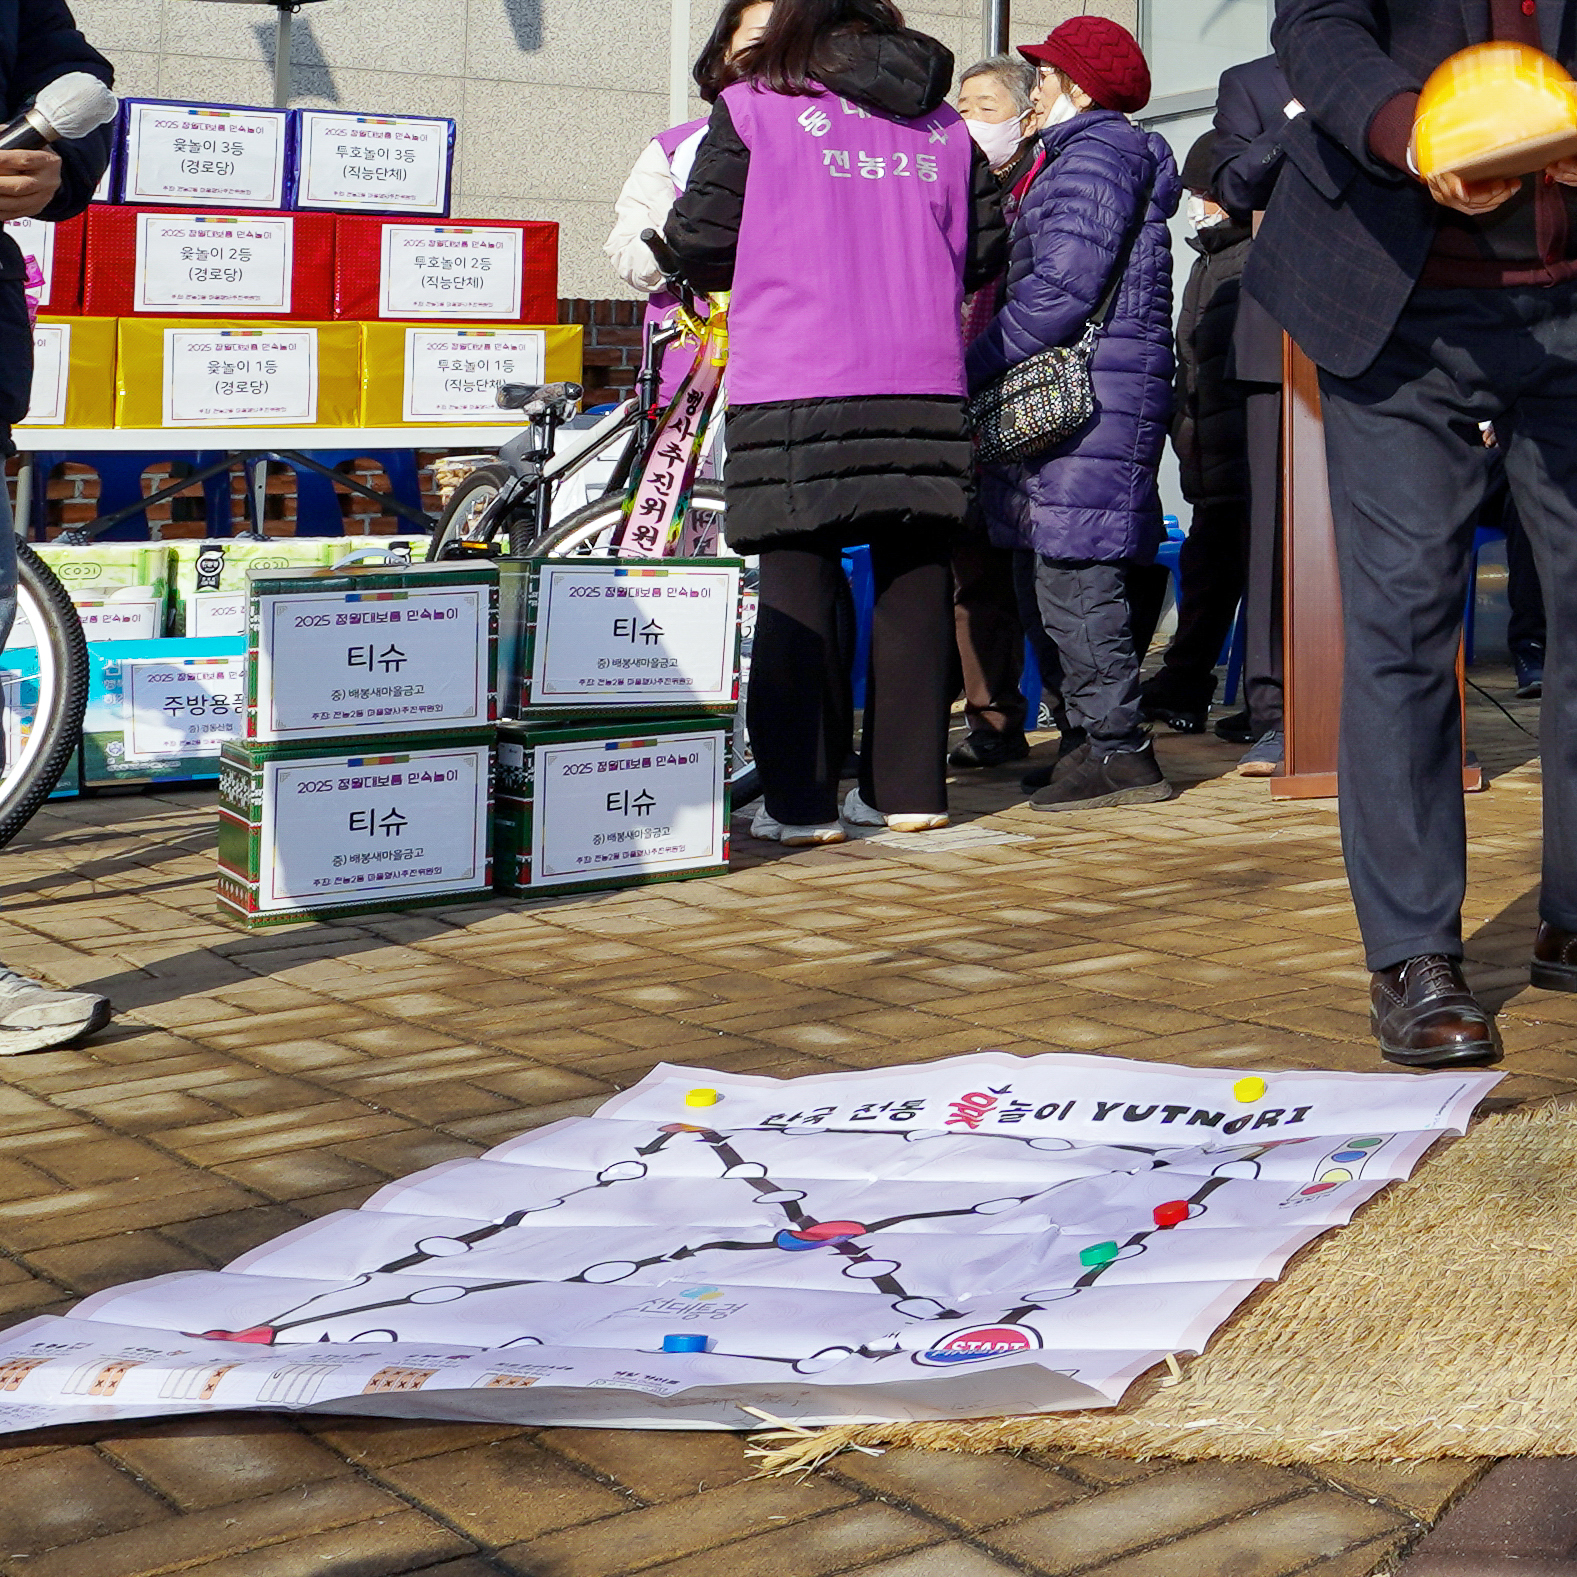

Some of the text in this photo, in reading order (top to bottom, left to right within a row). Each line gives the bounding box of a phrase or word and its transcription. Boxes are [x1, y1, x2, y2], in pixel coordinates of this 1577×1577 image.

[221, 141, 245, 156] 3등
[394, 149, 416, 163] 3등
[180, 158, 235, 177] (경로당)
[822, 149, 938, 182] 전농2동
[343, 165, 407, 182] (직능단체)
[228, 247, 252, 262] 2등
[471, 256, 492, 271] 2등
[188, 267, 243, 282] (경로당)
[421, 276, 484, 290] (직능단체)
[256, 360, 279, 374] 1등
[494, 359, 515, 373] 1등
[215, 380, 269, 395] (경로당)
[630, 388, 705, 556] 행사추진위원
[569, 586, 601, 598] 2025
[211, 606, 237, 616] 2025
[294, 614, 331, 628] 2025
[613, 617, 665, 646] 티슈
[347, 643, 408, 673] 티슈
[148, 673, 174, 683] 2025
[562, 763, 593, 776] 2025
[297, 780, 333, 794] 2025
[606, 788, 657, 817] 티슈
[349, 807, 408, 838] 티슈
[849, 1098, 927, 1122] 전통
[1091, 1101, 1314, 1135] YUTNORI
